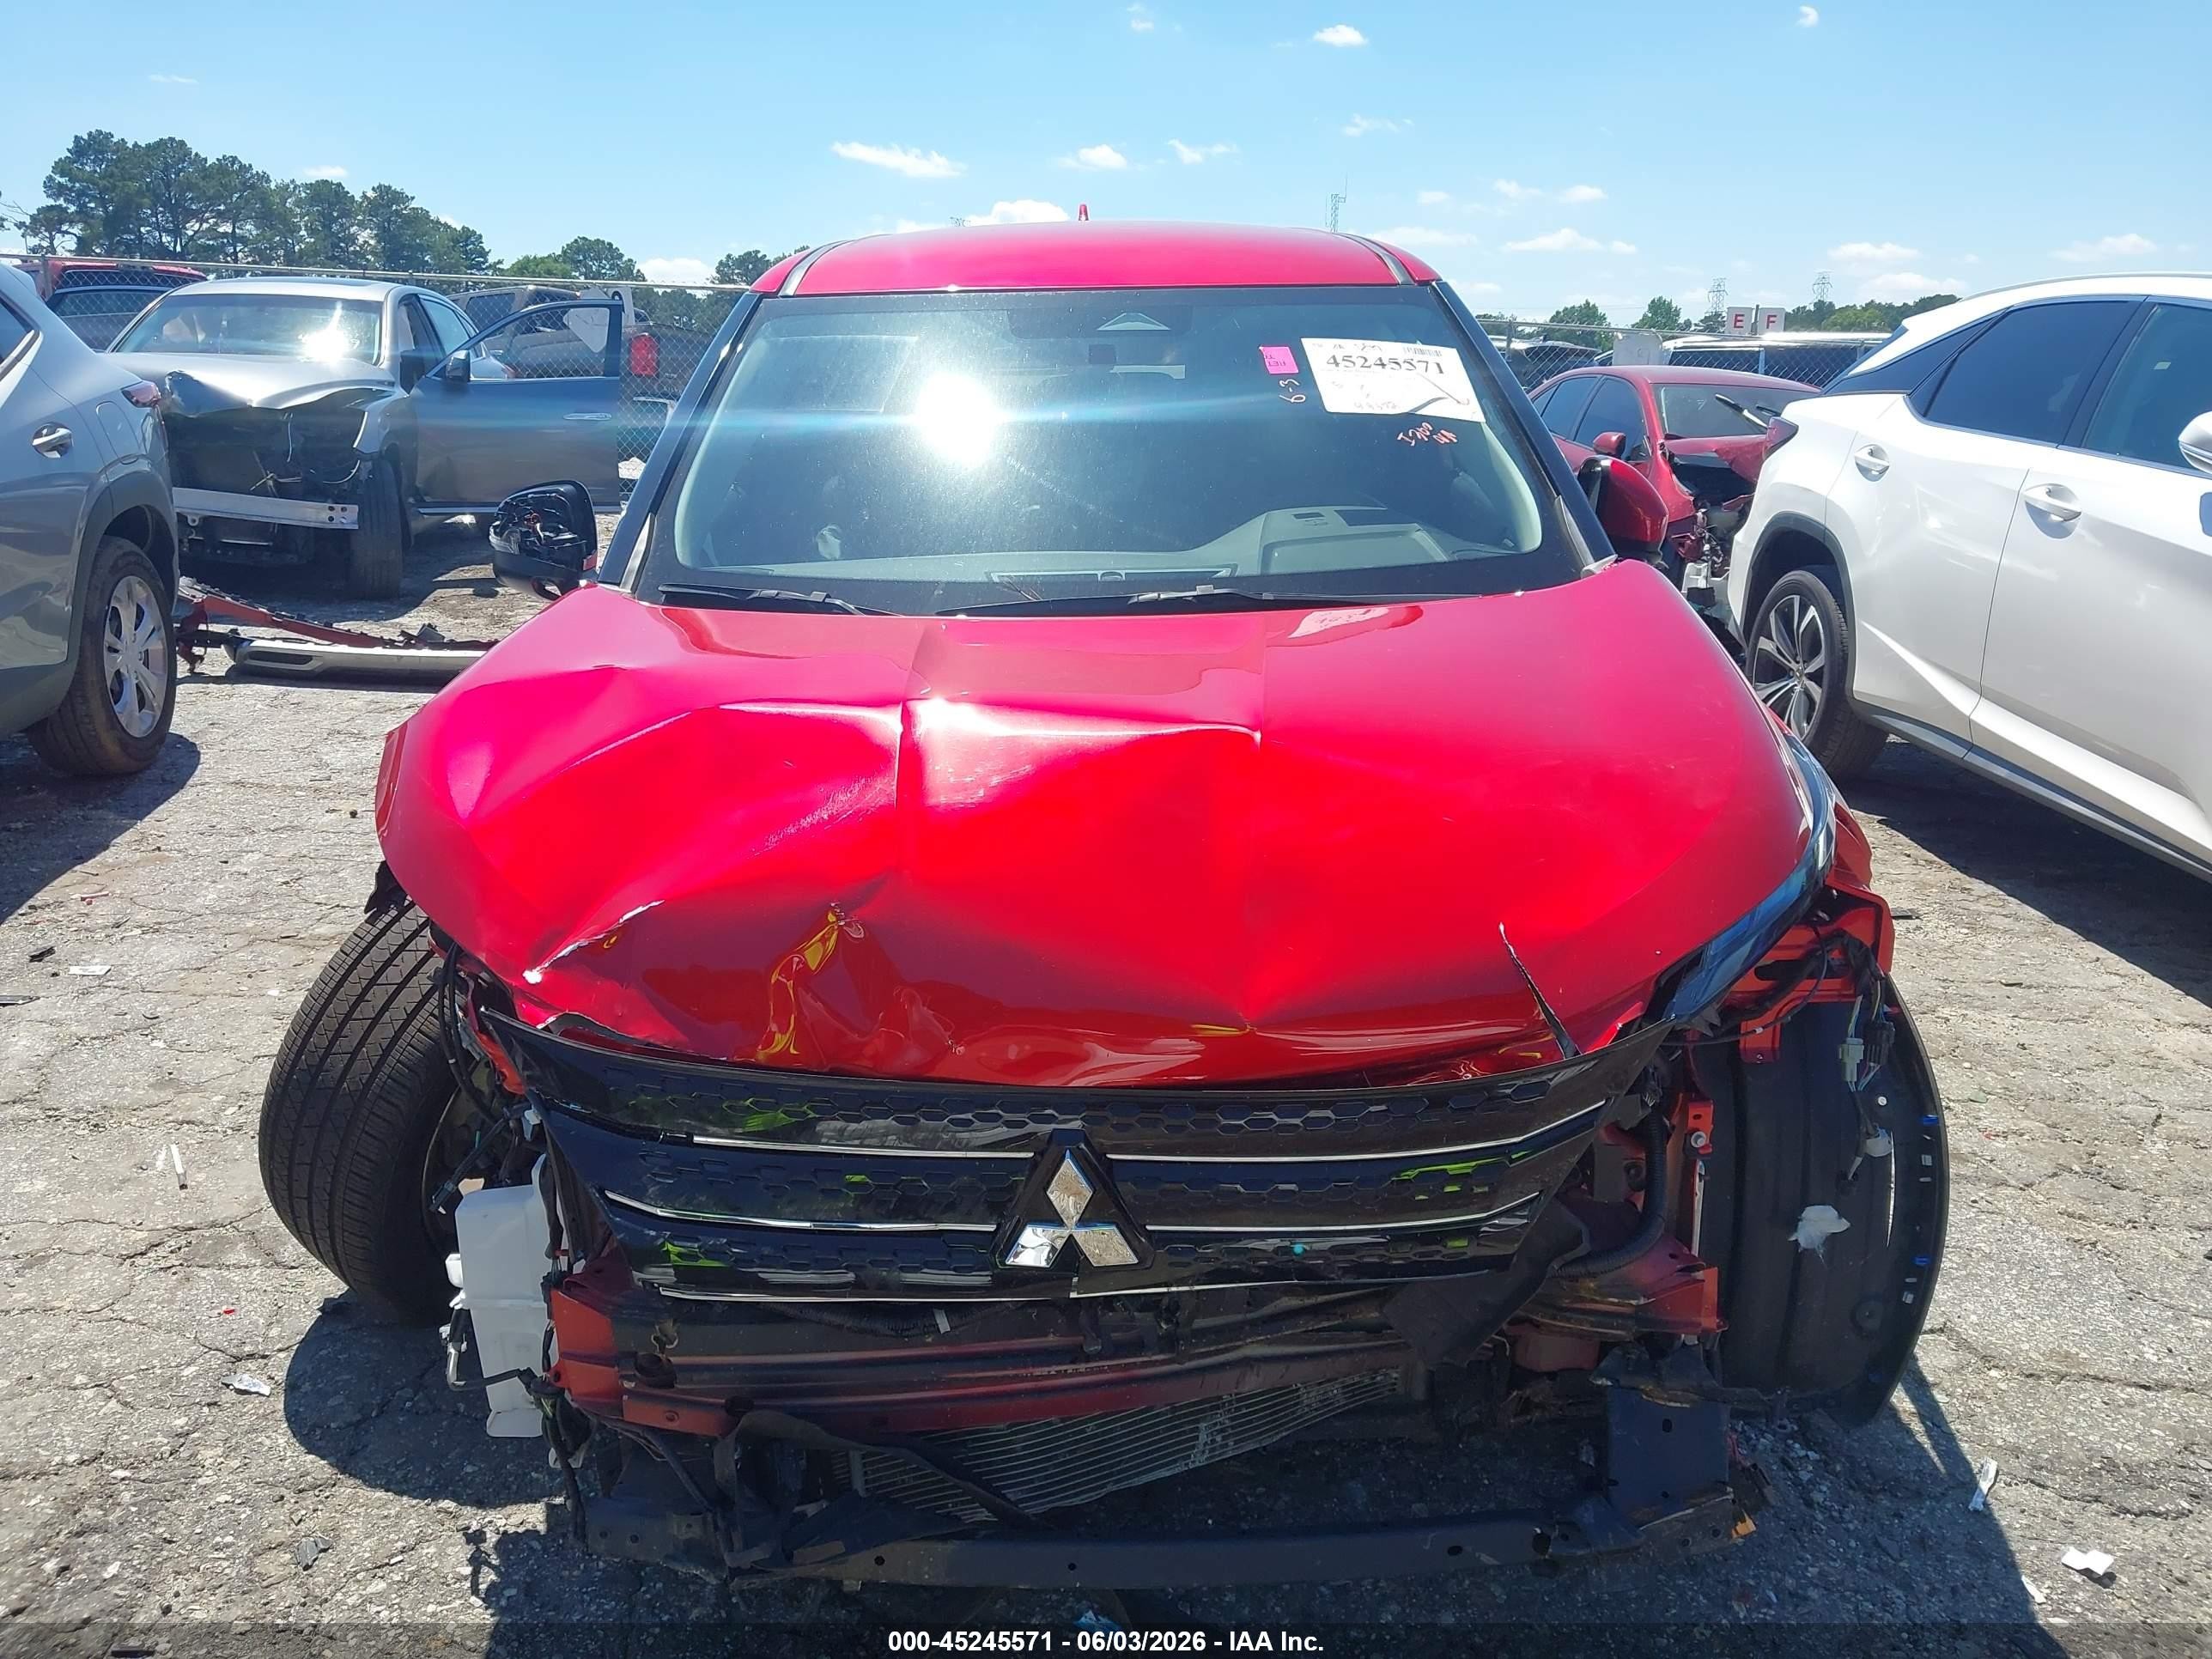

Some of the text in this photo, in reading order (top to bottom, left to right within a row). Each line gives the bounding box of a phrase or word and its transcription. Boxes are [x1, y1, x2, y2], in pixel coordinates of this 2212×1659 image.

[1733, 313, 1745, 328] E
[1766, 314, 1777, 329] F
[1326, 354, 1444, 374] 45245571
